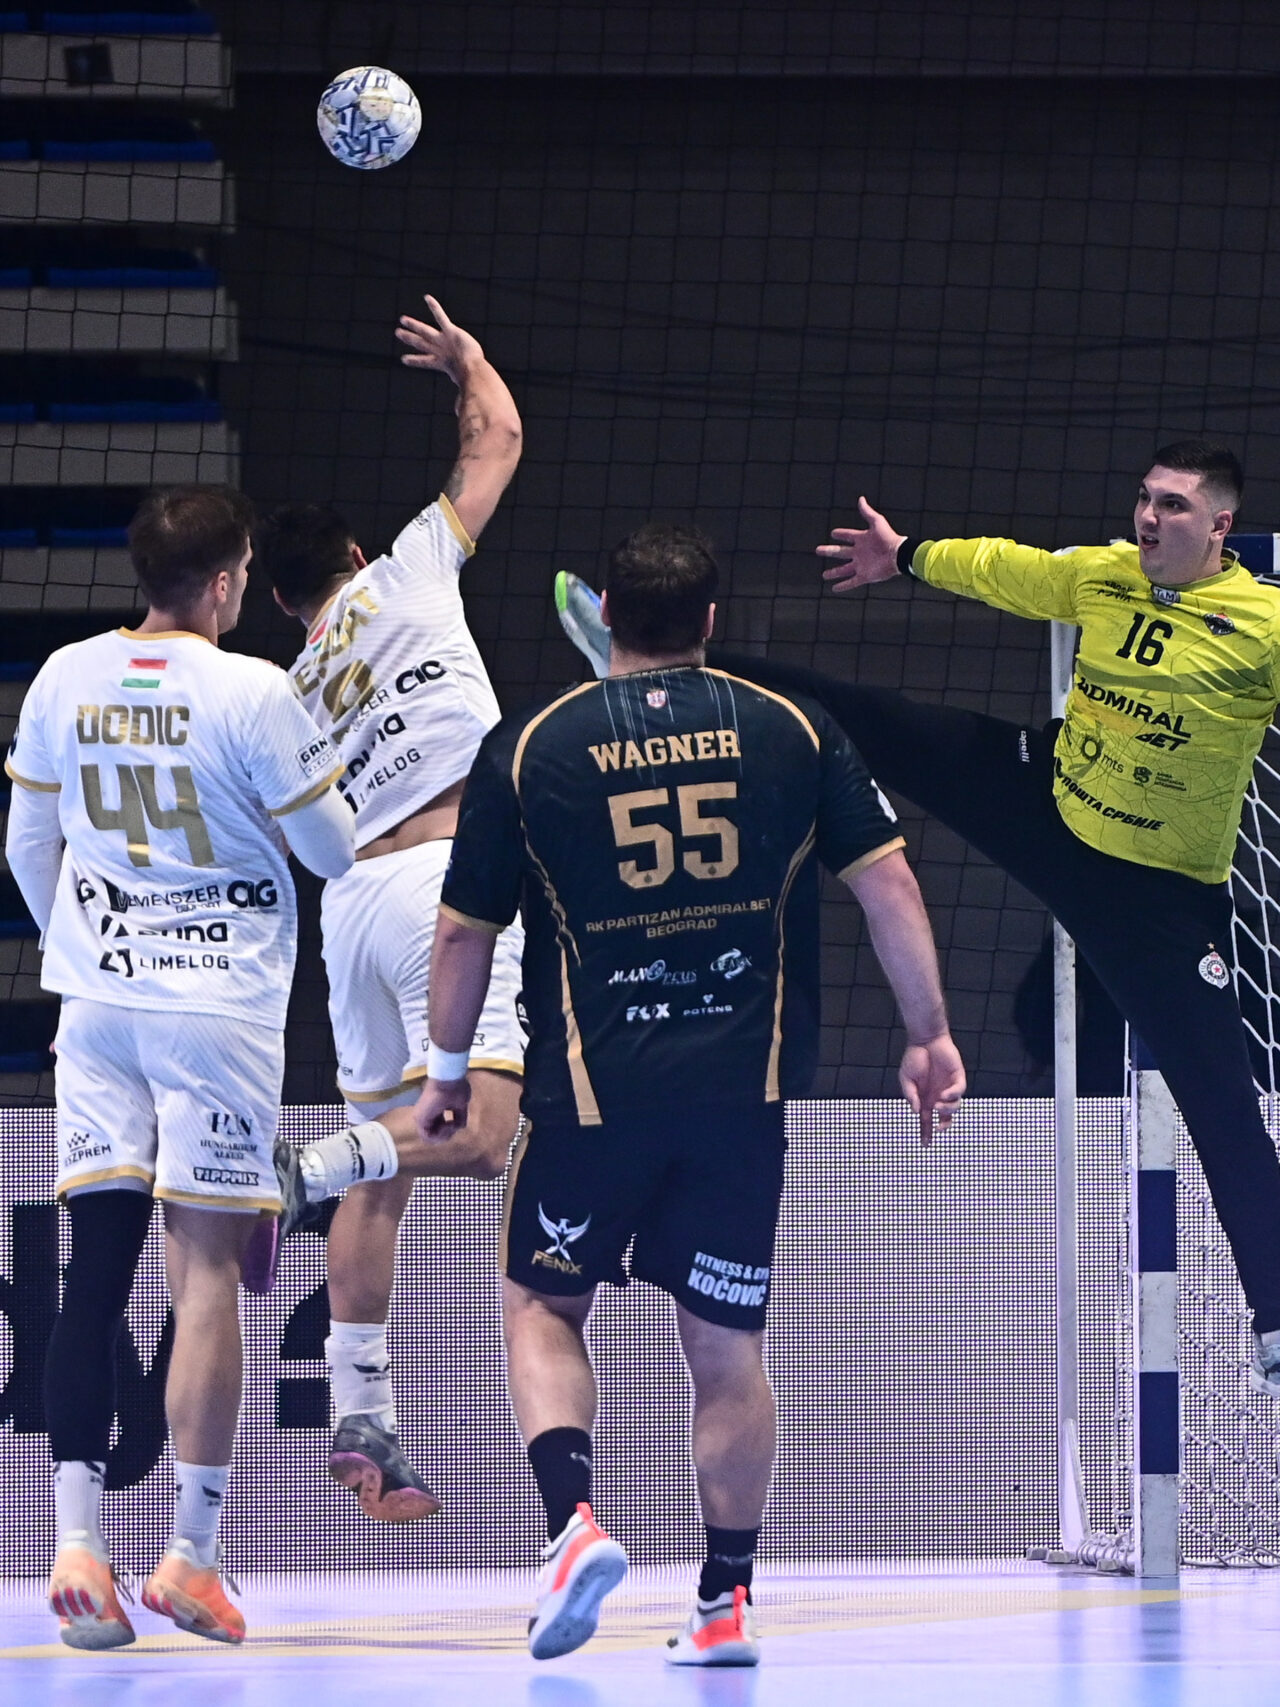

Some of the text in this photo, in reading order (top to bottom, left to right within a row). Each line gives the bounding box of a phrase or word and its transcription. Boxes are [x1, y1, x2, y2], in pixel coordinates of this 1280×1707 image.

[1115, 611, 1174, 667] 16
[1077, 676, 1192, 738] ADMIRAL
[76, 704, 190, 746] DODIC
[588, 728, 742, 773] WAGNER
[1135, 732, 1190, 751] BET
[1101, 754, 1125, 773] mts
[80, 763, 216, 868] 44
[1062, 777, 1166, 831] ПОШТА СРБИЈЕ
[607, 781, 740, 889] 55
[226, 878, 279, 909] CIG
[586, 920, 605, 933] RK
[606, 907, 682, 931] PARTIZAN
[646, 918, 718, 938] BEOGRAD
[139, 953, 230, 971] LIMELOG
[193, 1166, 259, 1186] TIPPMIX
[531, 1250, 582, 1276] FENIX
[694, 1251, 742, 1279] FITNESS
[743, 1265, 753, 1279] &
